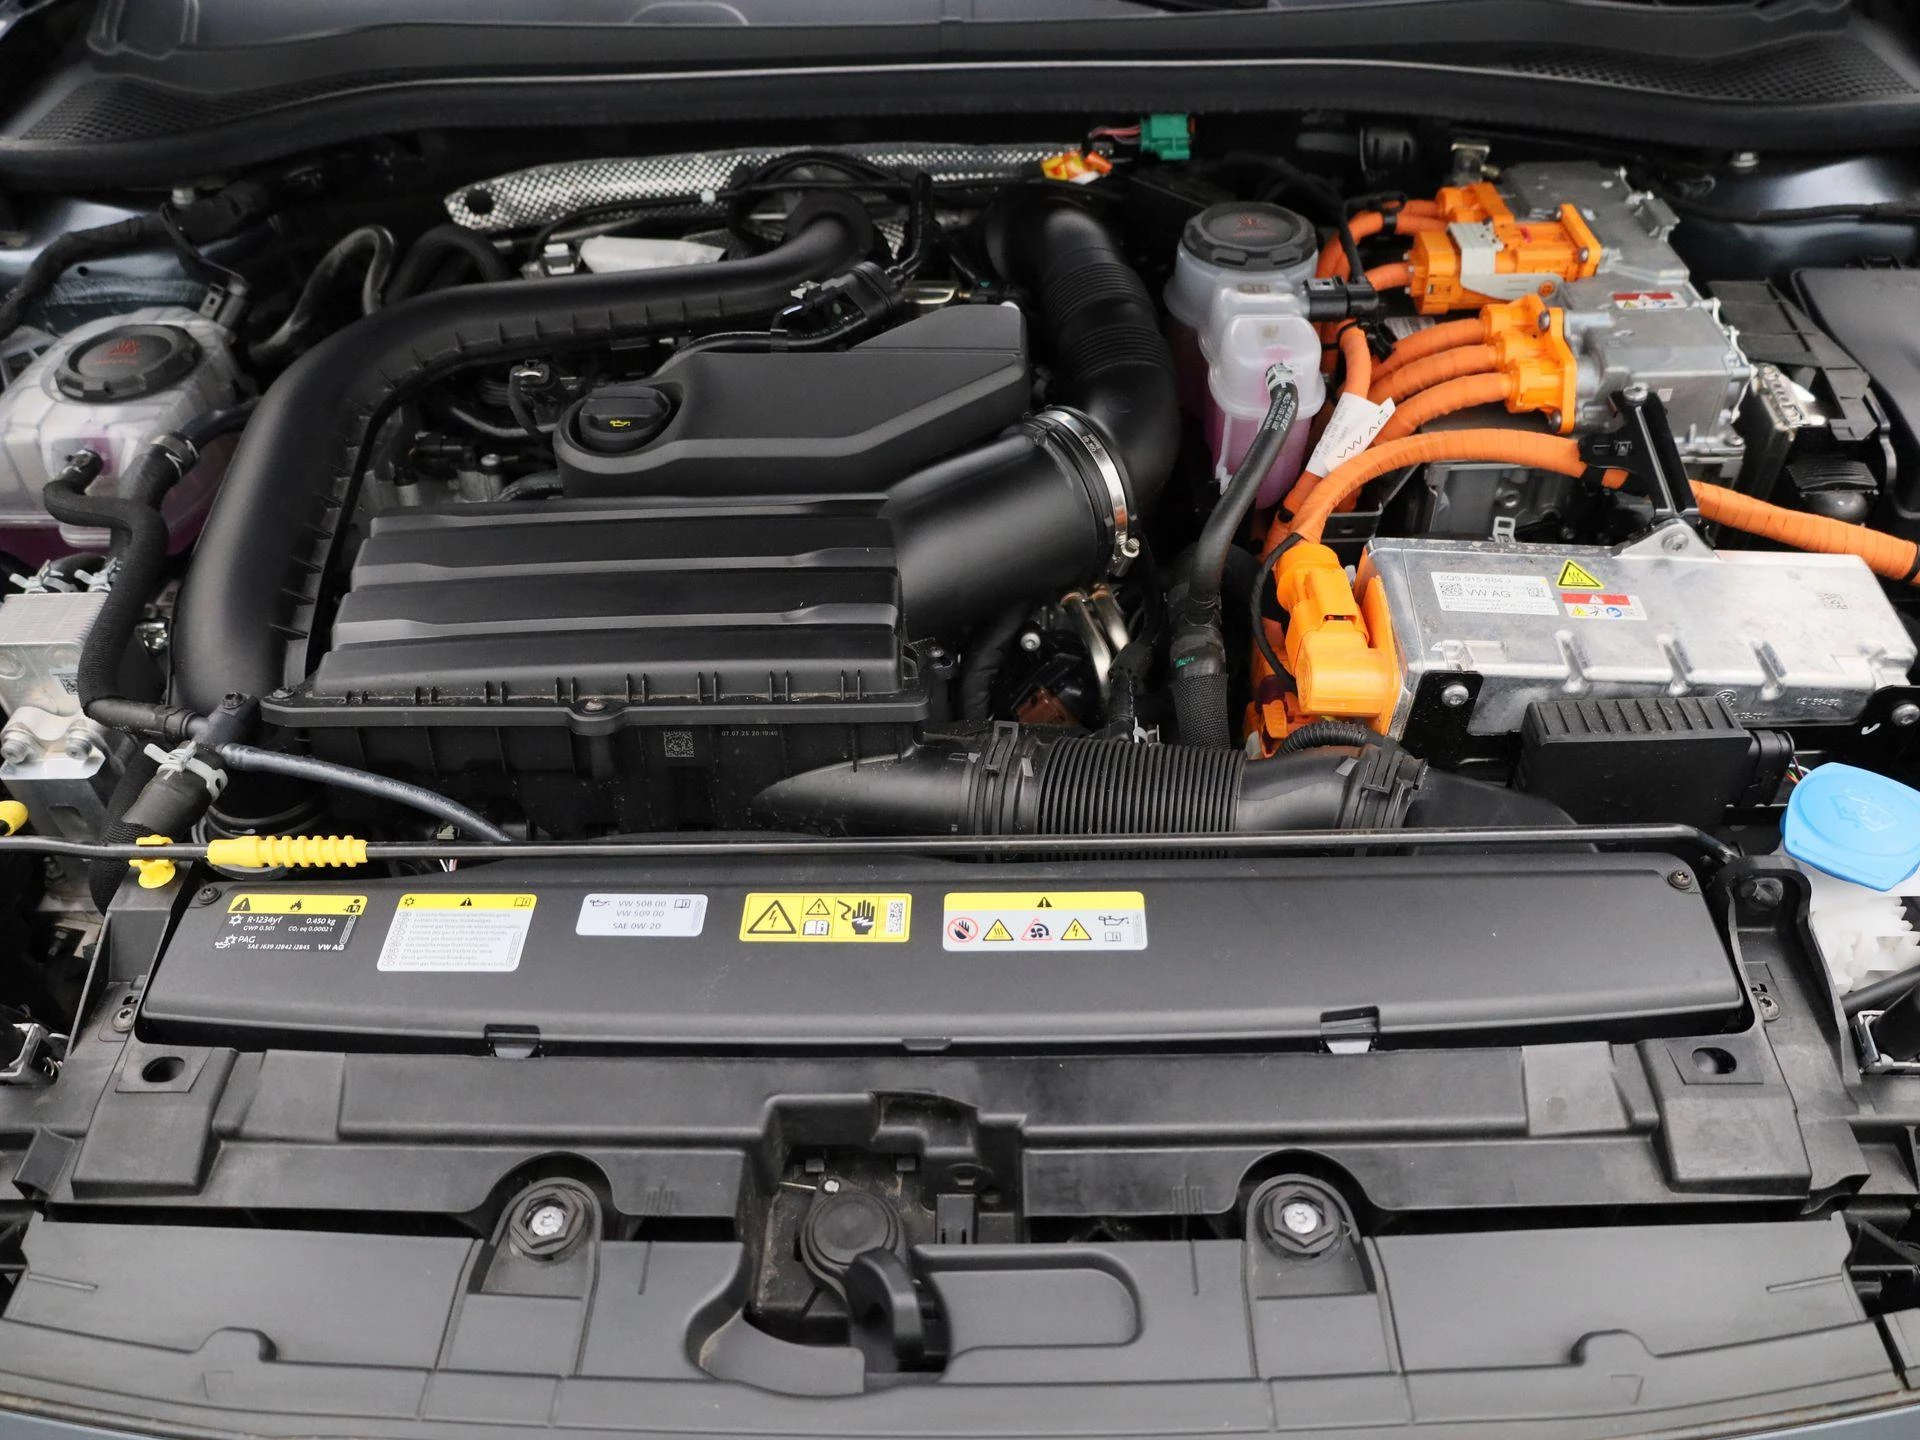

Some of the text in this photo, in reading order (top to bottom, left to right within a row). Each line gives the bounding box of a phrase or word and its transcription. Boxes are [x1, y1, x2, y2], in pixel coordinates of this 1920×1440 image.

[1465, 588, 1512, 598] VW AG
[247, 917, 336, 926] R-1234yf 0.450 kg
[238, 935, 256, 943] PAG
